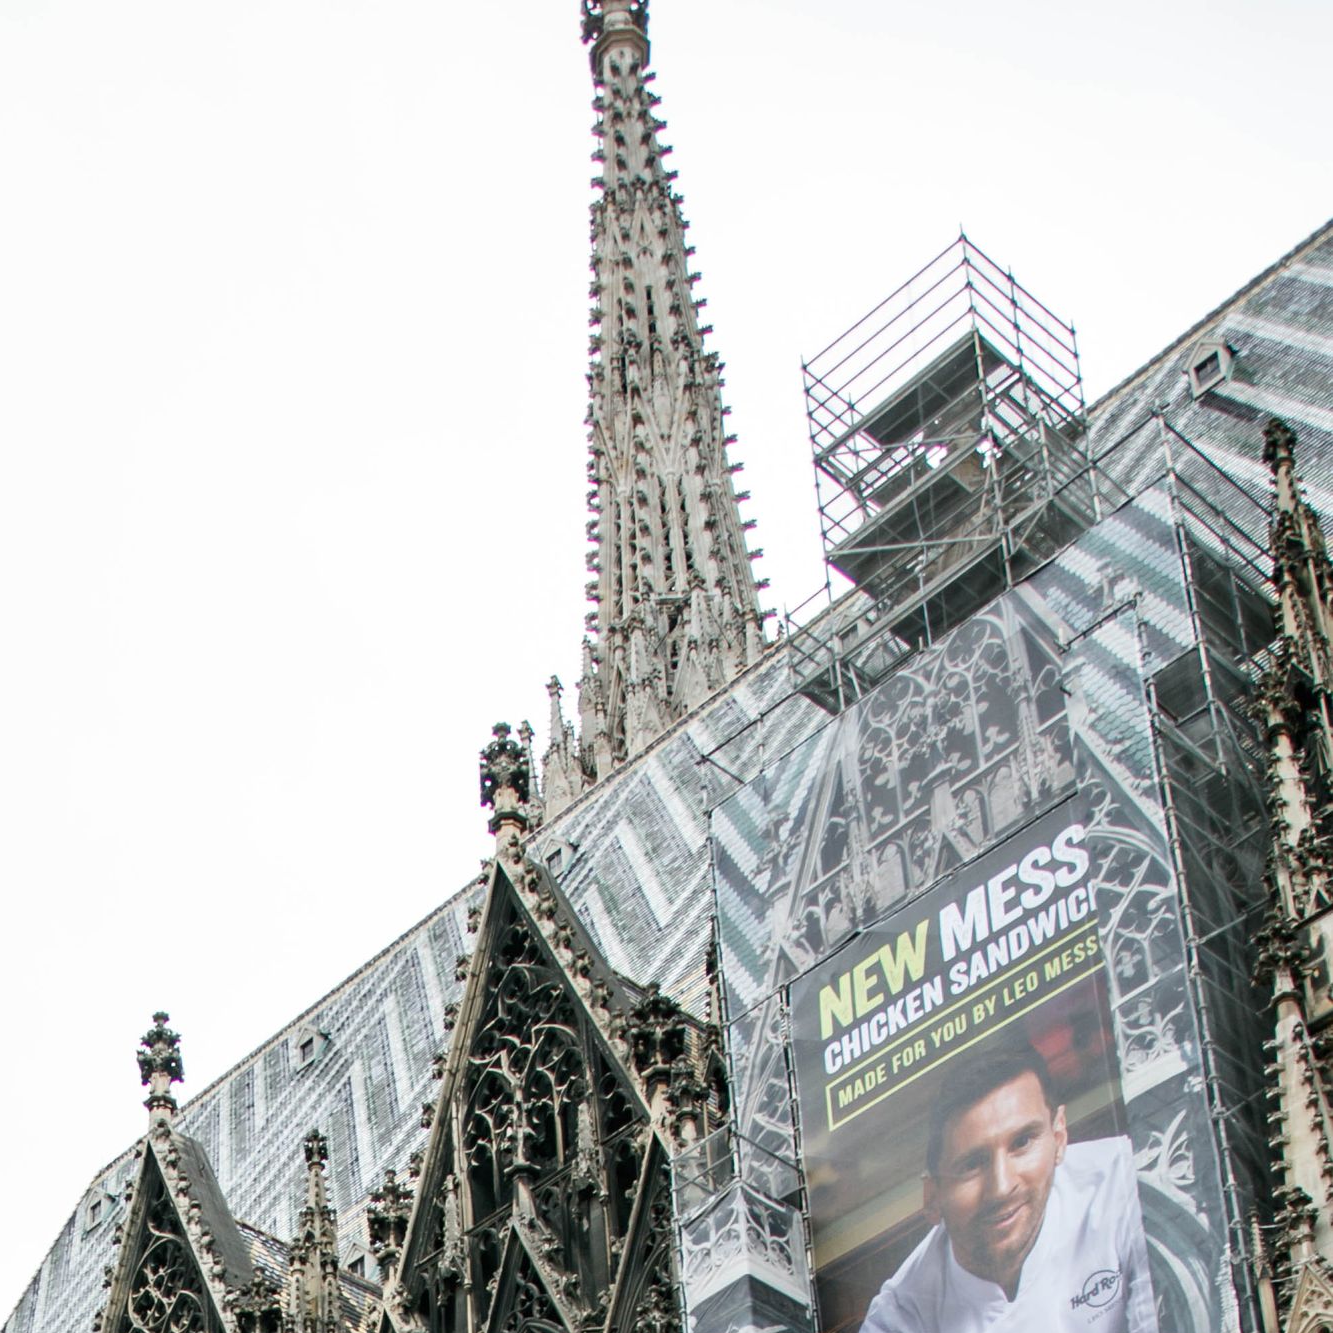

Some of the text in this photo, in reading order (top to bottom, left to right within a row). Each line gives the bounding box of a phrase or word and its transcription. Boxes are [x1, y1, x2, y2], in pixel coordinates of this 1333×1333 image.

[819, 919, 929, 1040] NEW
[824, 975, 944, 1075] CHICKEN
[838, 1063, 888, 1109] MADE
[892, 1040, 927, 1075] FOR
[931, 1014, 968, 1048] YOU
[972, 996, 997, 1026] BY
[1002, 971, 1039, 1007] LEO
